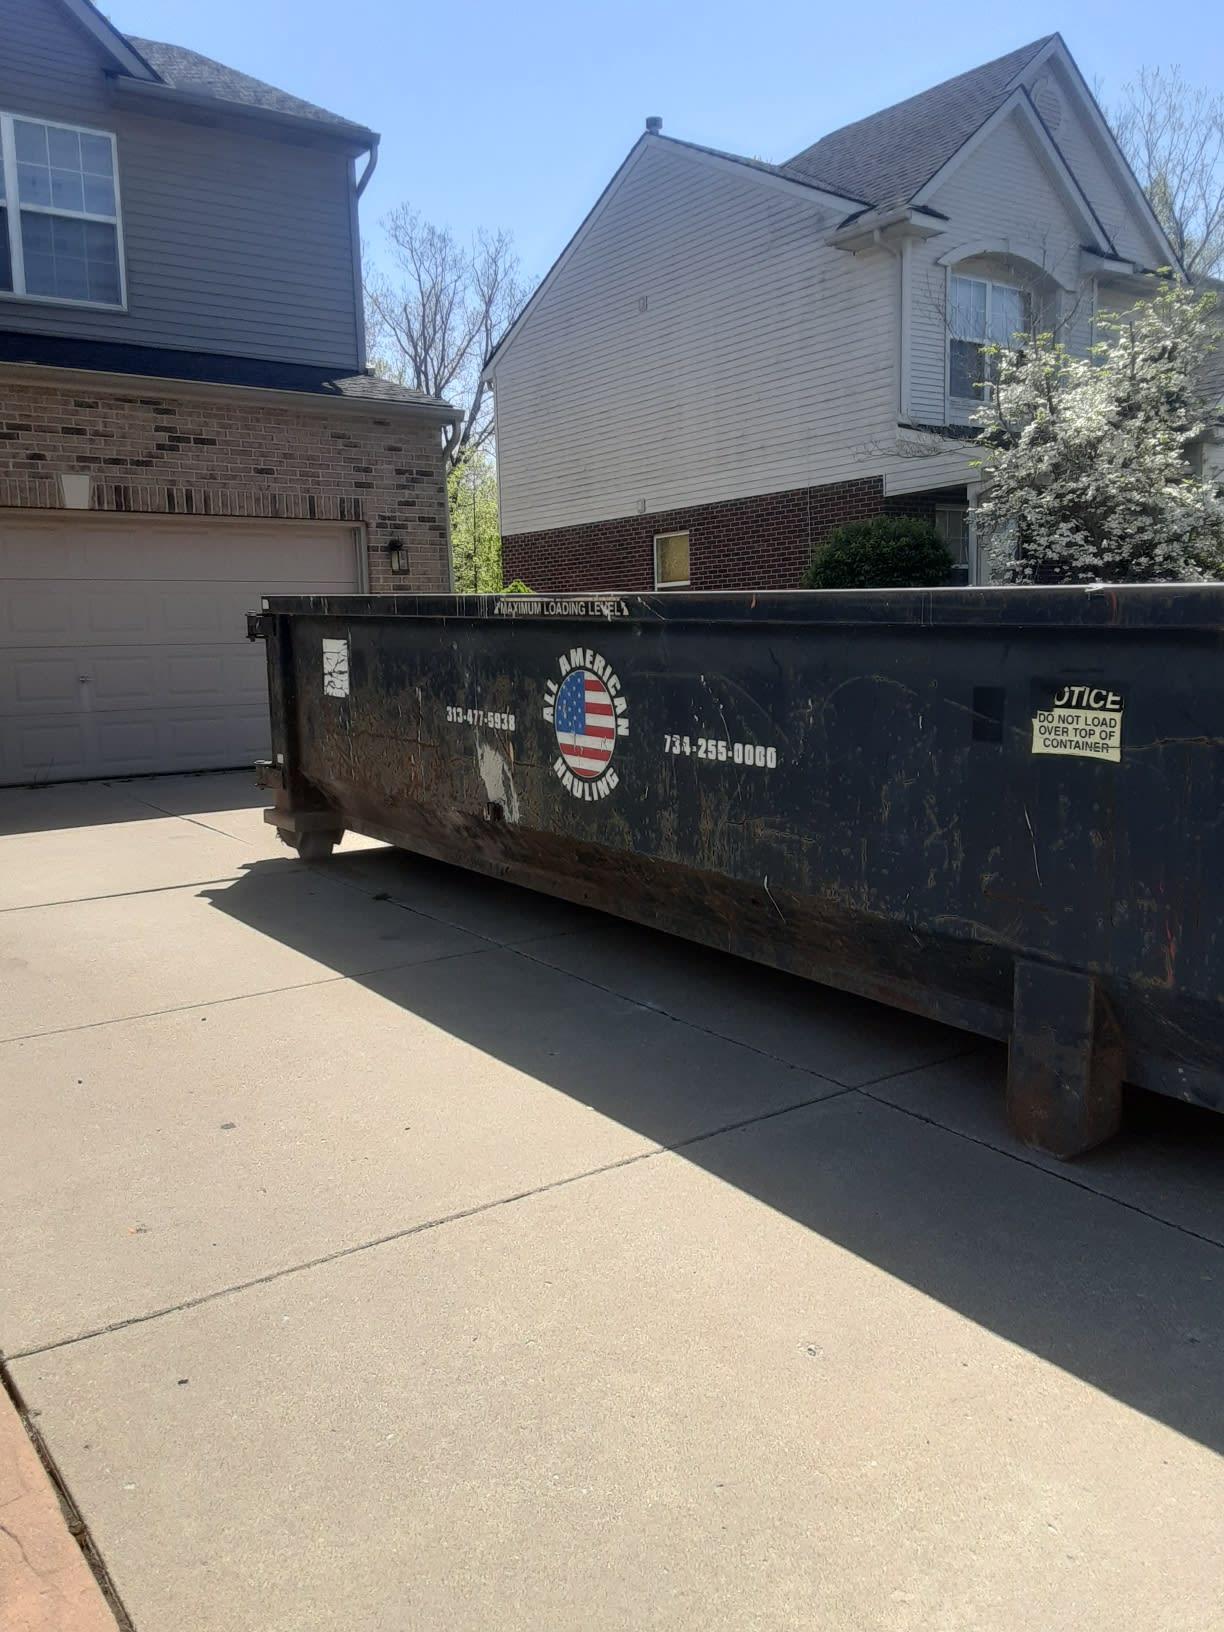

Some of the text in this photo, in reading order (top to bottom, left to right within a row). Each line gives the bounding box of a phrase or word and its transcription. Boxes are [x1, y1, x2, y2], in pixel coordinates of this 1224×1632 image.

[500, 601, 621, 616] MAXIMUM LOADING LEVEL
[543, 647, 630, 736] ALL AMERICAN
[1054, 686, 1121, 709] OTICE
[446, 706, 516, 731] 313-477-5938
[1038, 713, 1117, 729] DO NOT LOAD
[1038, 725, 1116, 741] OVER TOP OF
[664, 734, 777, 769] 734-255-0000
[1043, 738, 1109, 753] CONTAINER
[553, 757, 620, 801] HAULING
